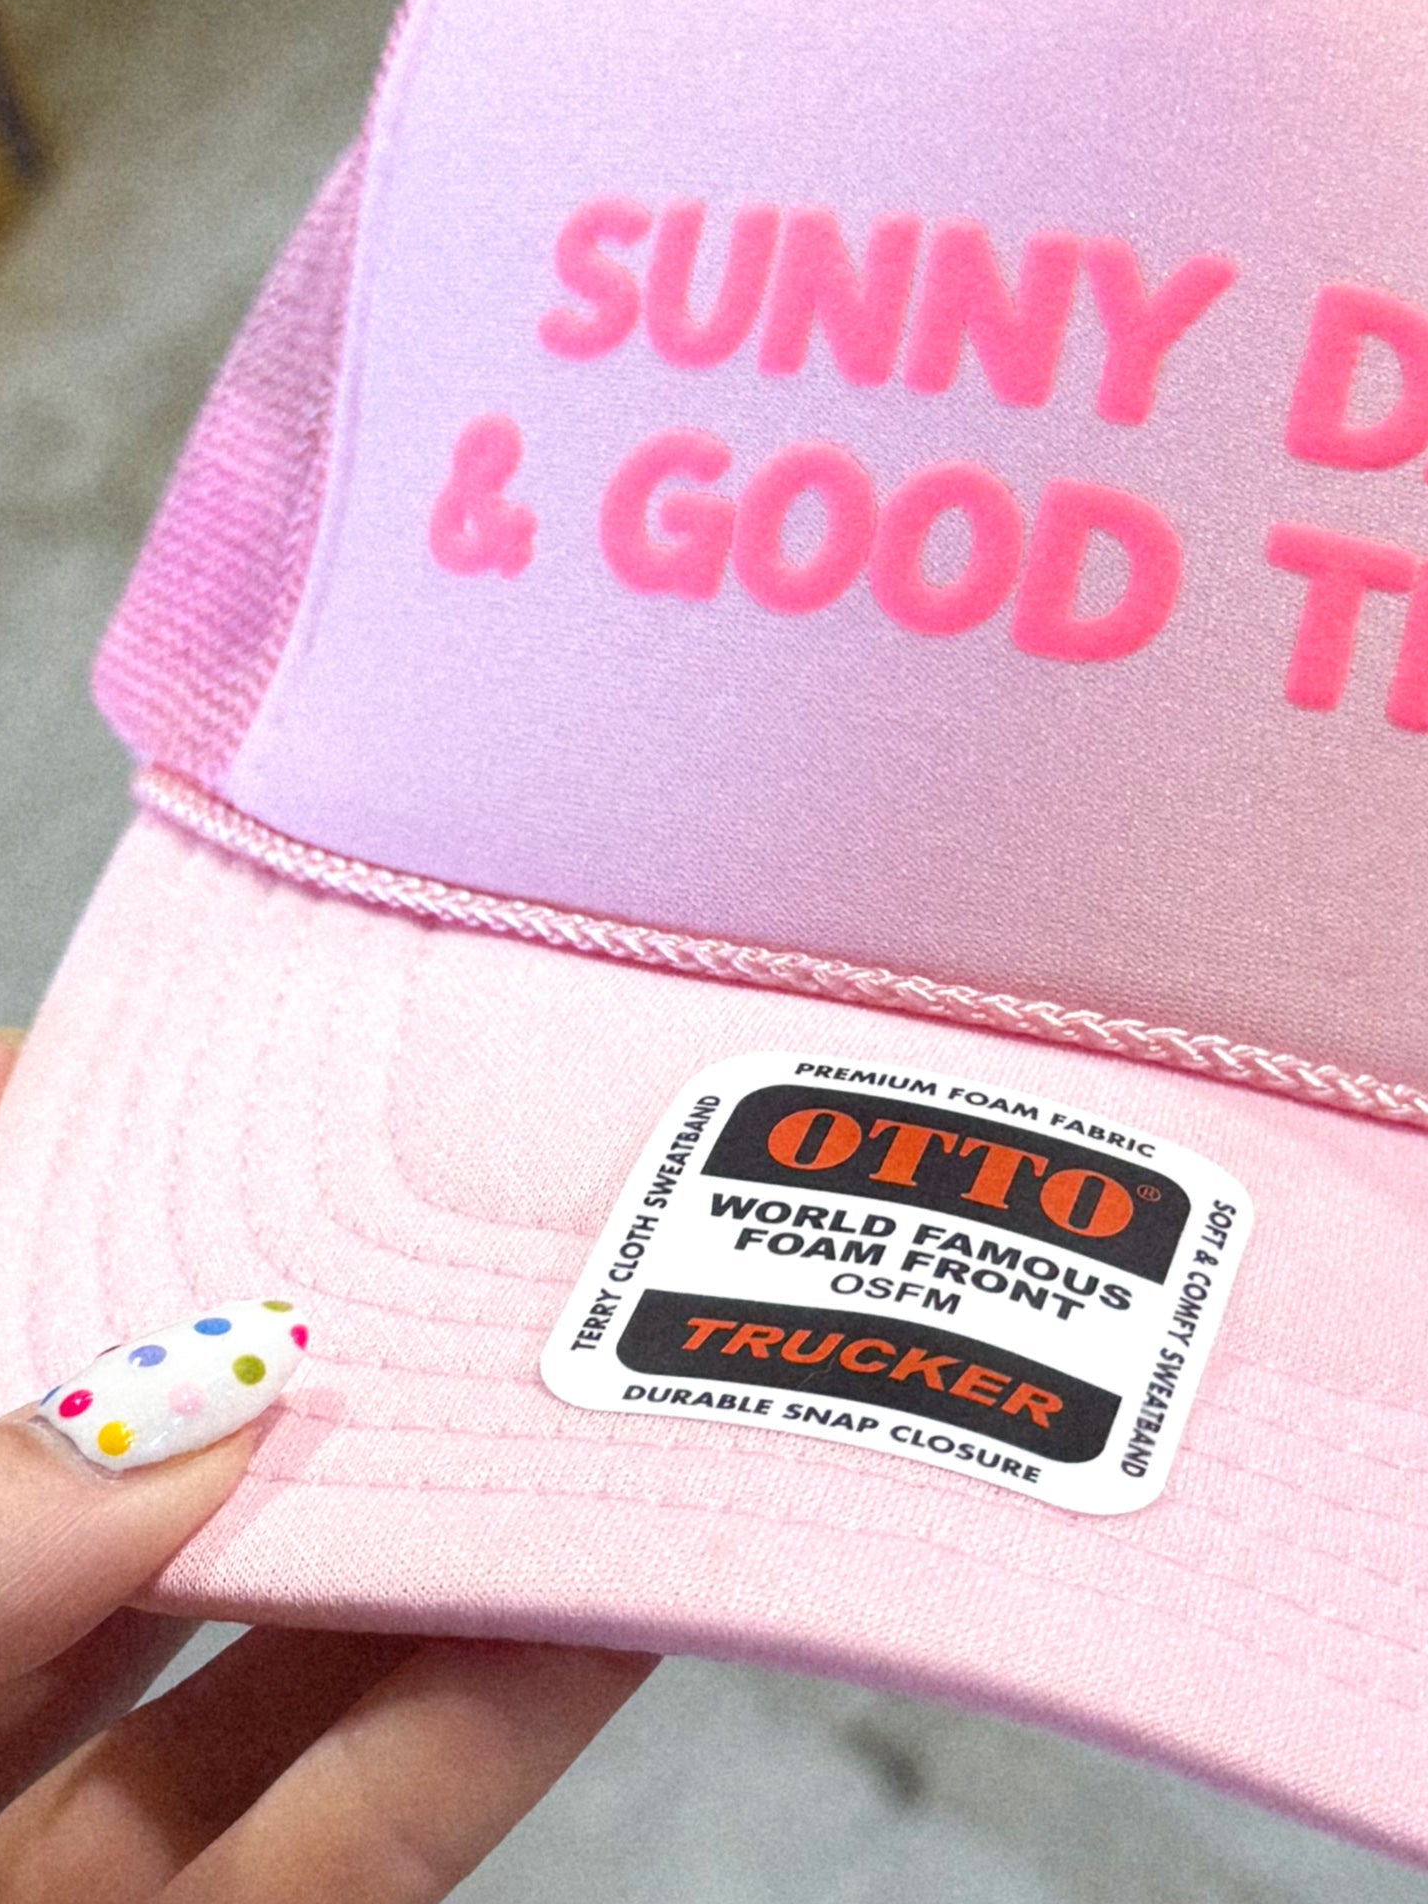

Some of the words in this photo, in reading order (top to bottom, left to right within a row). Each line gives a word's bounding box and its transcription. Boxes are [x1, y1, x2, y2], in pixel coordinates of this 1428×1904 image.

[538, 195, 1237, 426] SUNNY
[428, 413, 537, 579] &
[600, 427, 1183, 662] GOOD
[795, 1063, 937, 1096] PREMIUM
[948, 1087, 1038, 1120] FOAM
[1050, 1113, 1156, 1158] FABRIC
[571, 1288, 622, 1350] TERRY
[609, 1215, 659, 1283] CLOTH
[644, 1095, 721, 1209] SWEATBAND
[710, 1193, 896, 1238] WORLD
[912, 1224, 1132, 1311] FAMOUS
[1194, 1250, 1219, 1266] &
[1202, 1200, 1236, 1251] SOFT
[734, 1227, 886, 1266] FOAM
[901, 1250, 1085, 1320] FRONT
[830, 1273, 961, 1314] OSFM
[1167, 1270, 1211, 1347] COMFY
[681, 1317, 1063, 1429] TRUCKER
[1121, 1347, 1185, 1479] SWEATBAND
[622, 1385, 773, 1415] DURABLE
[782, 1403, 879, 1433] SNAP
[890, 1425, 1041, 1483] CLOSURE
